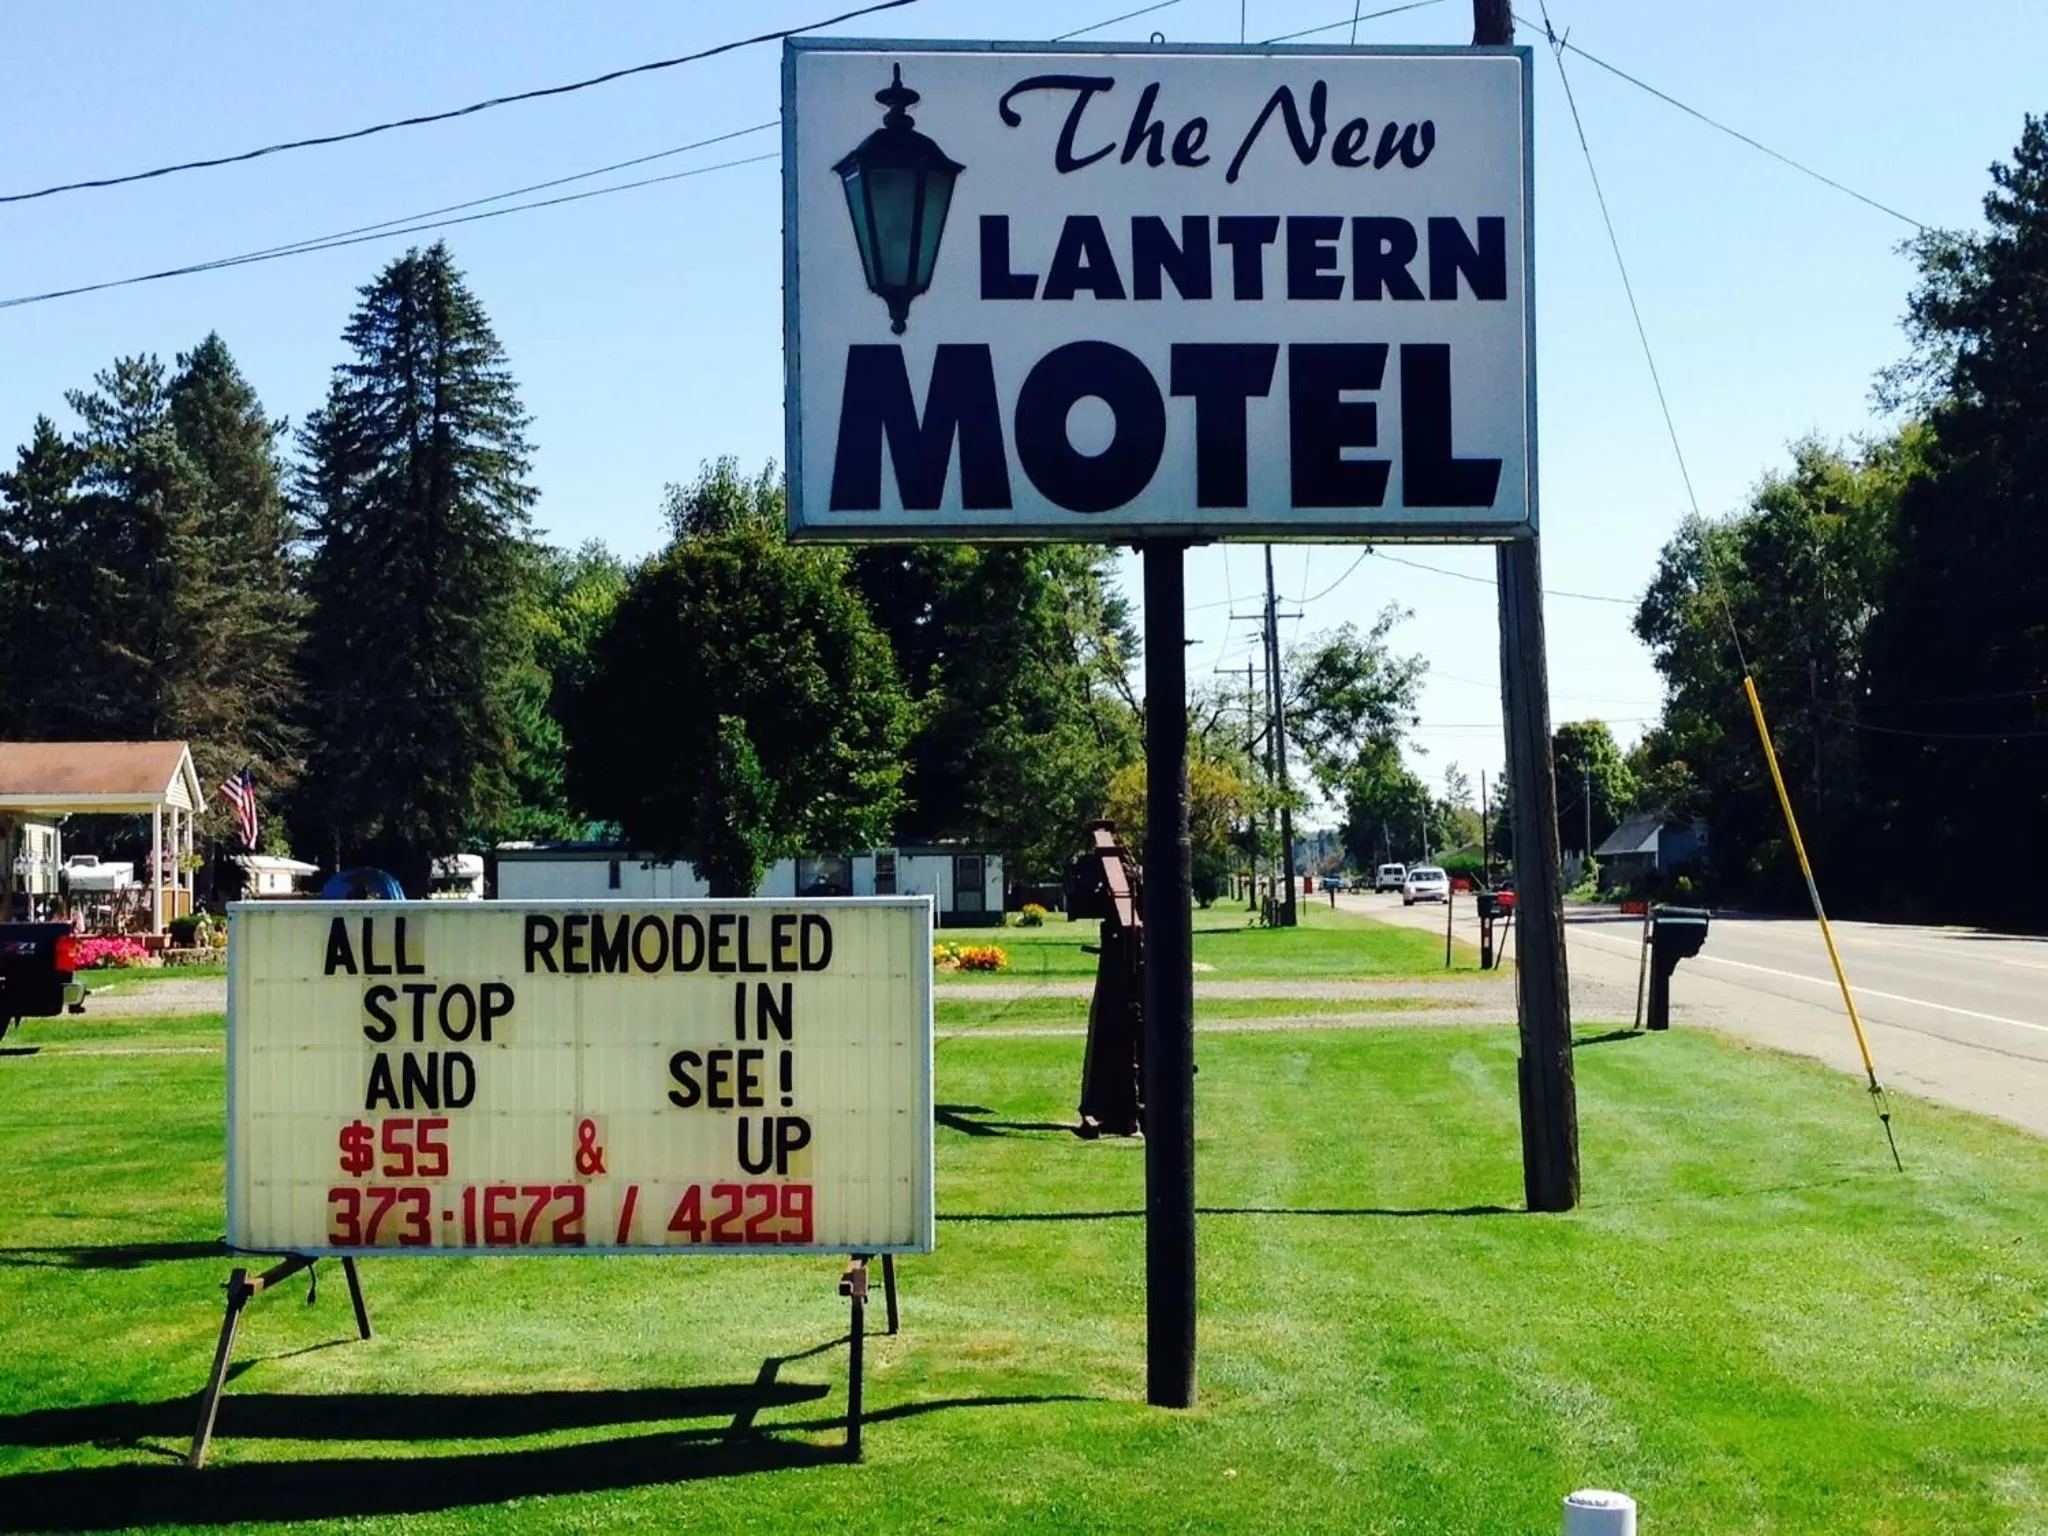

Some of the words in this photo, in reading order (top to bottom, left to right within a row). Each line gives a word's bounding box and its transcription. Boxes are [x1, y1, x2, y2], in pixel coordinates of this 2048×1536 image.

[999, 75, 1210, 173] The
[1226, 79, 1436, 183] New
[980, 215, 1507, 301] LANTERN
[829, 340, 1503, 513] MOTEL
[324, 916, 425, 975] ALL
[524, 913, 833, 974] REMODELED
[363, 982, 515, 1043] STOP
[735, 982, 793, 1041] IN
[366, 1052, 476, 1110] AND
[668, 1049, 794, 1108] SEE!
[339, 1119, 449, 1178] $55
[575, 1119, 606, 1176] &
[738, 1117, 812, 1176] UP
[616, 1186, 639, 1245] /
[668, 1184, 814, 1244] 4229
